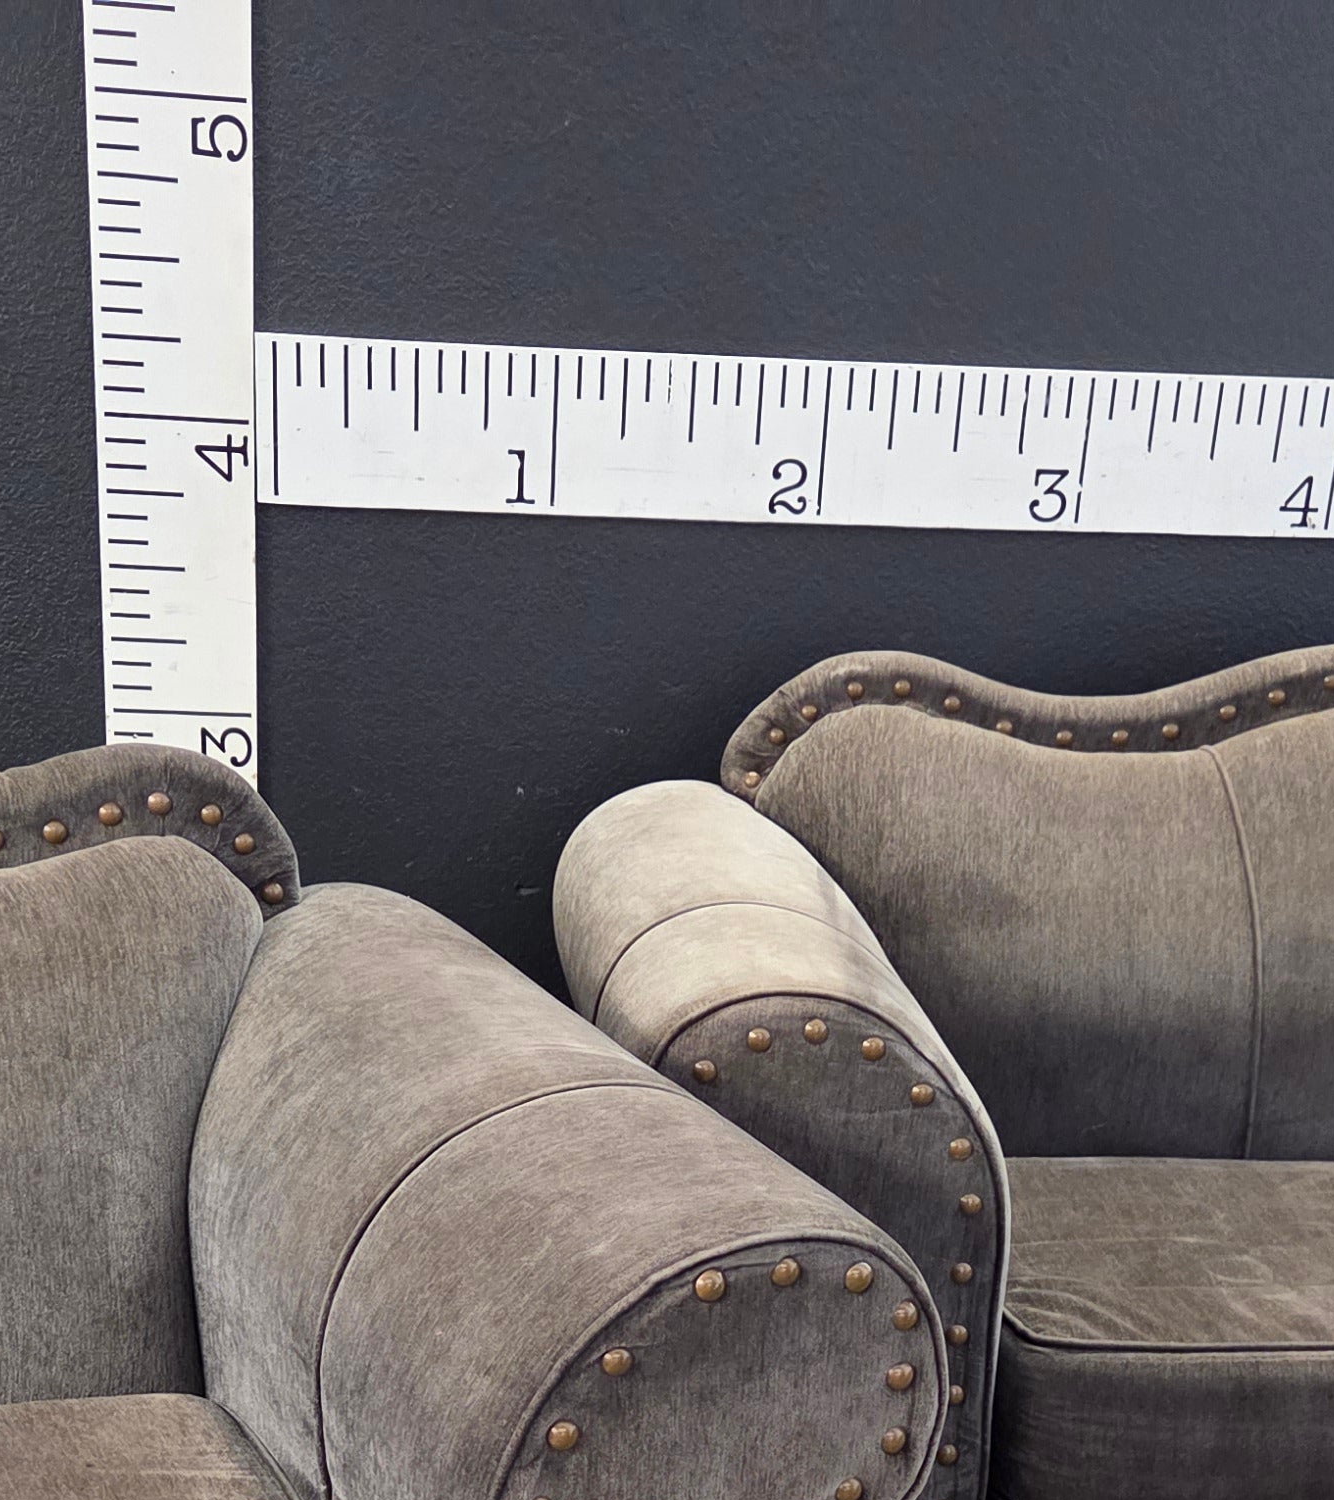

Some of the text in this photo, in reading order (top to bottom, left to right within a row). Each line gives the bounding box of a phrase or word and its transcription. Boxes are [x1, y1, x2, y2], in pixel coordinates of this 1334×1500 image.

[191, 114, 252, 768] 3 4 5
[505, 449, 536, 505] 1
[768, 458, 809, 515] 2
[1028, 468, 1070, 523] 3
[1279, 475, 1319, 529] 4
